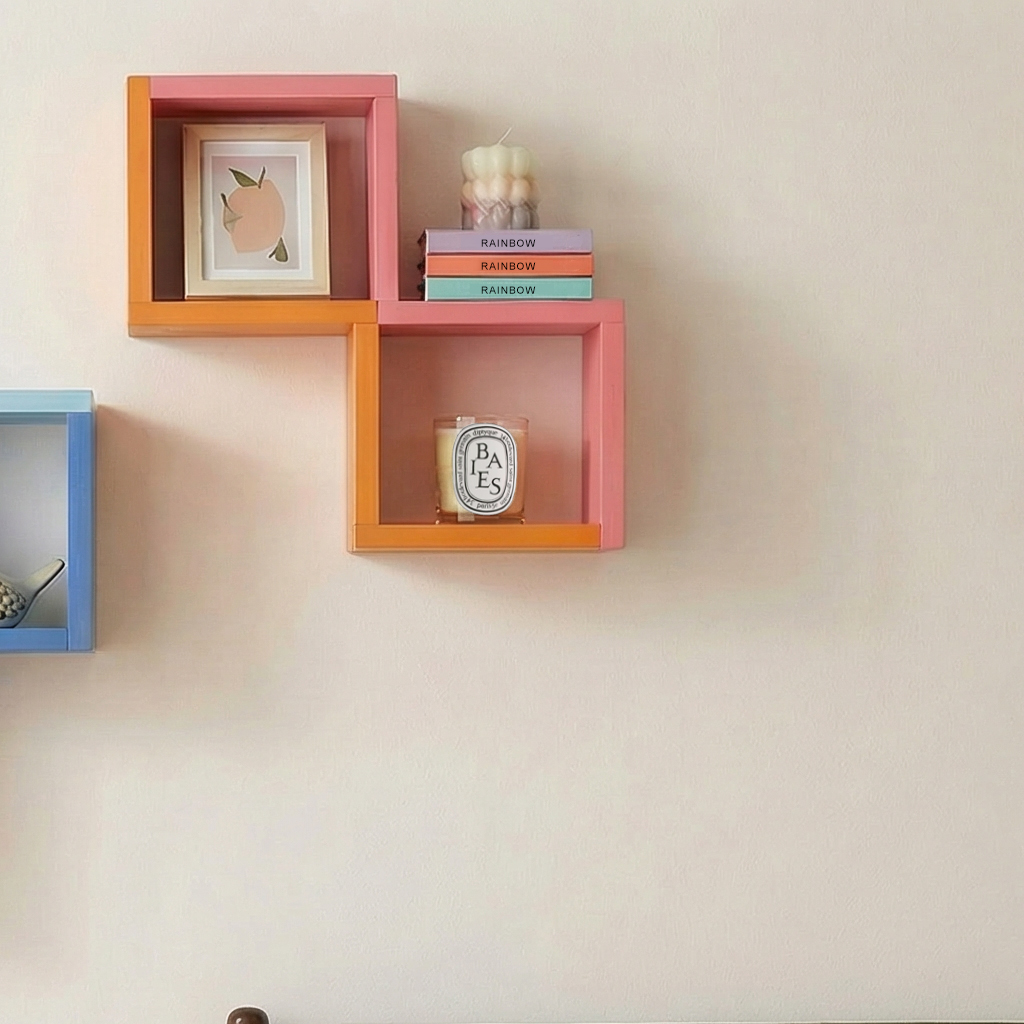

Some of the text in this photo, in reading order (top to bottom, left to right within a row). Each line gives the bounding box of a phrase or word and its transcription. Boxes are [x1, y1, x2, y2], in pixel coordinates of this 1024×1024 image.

[481, 239, 536, 248] RAINBOW
[481, 262, 536, 271] RAINBOW
[481, 286, 536, 295] RAINBOW
